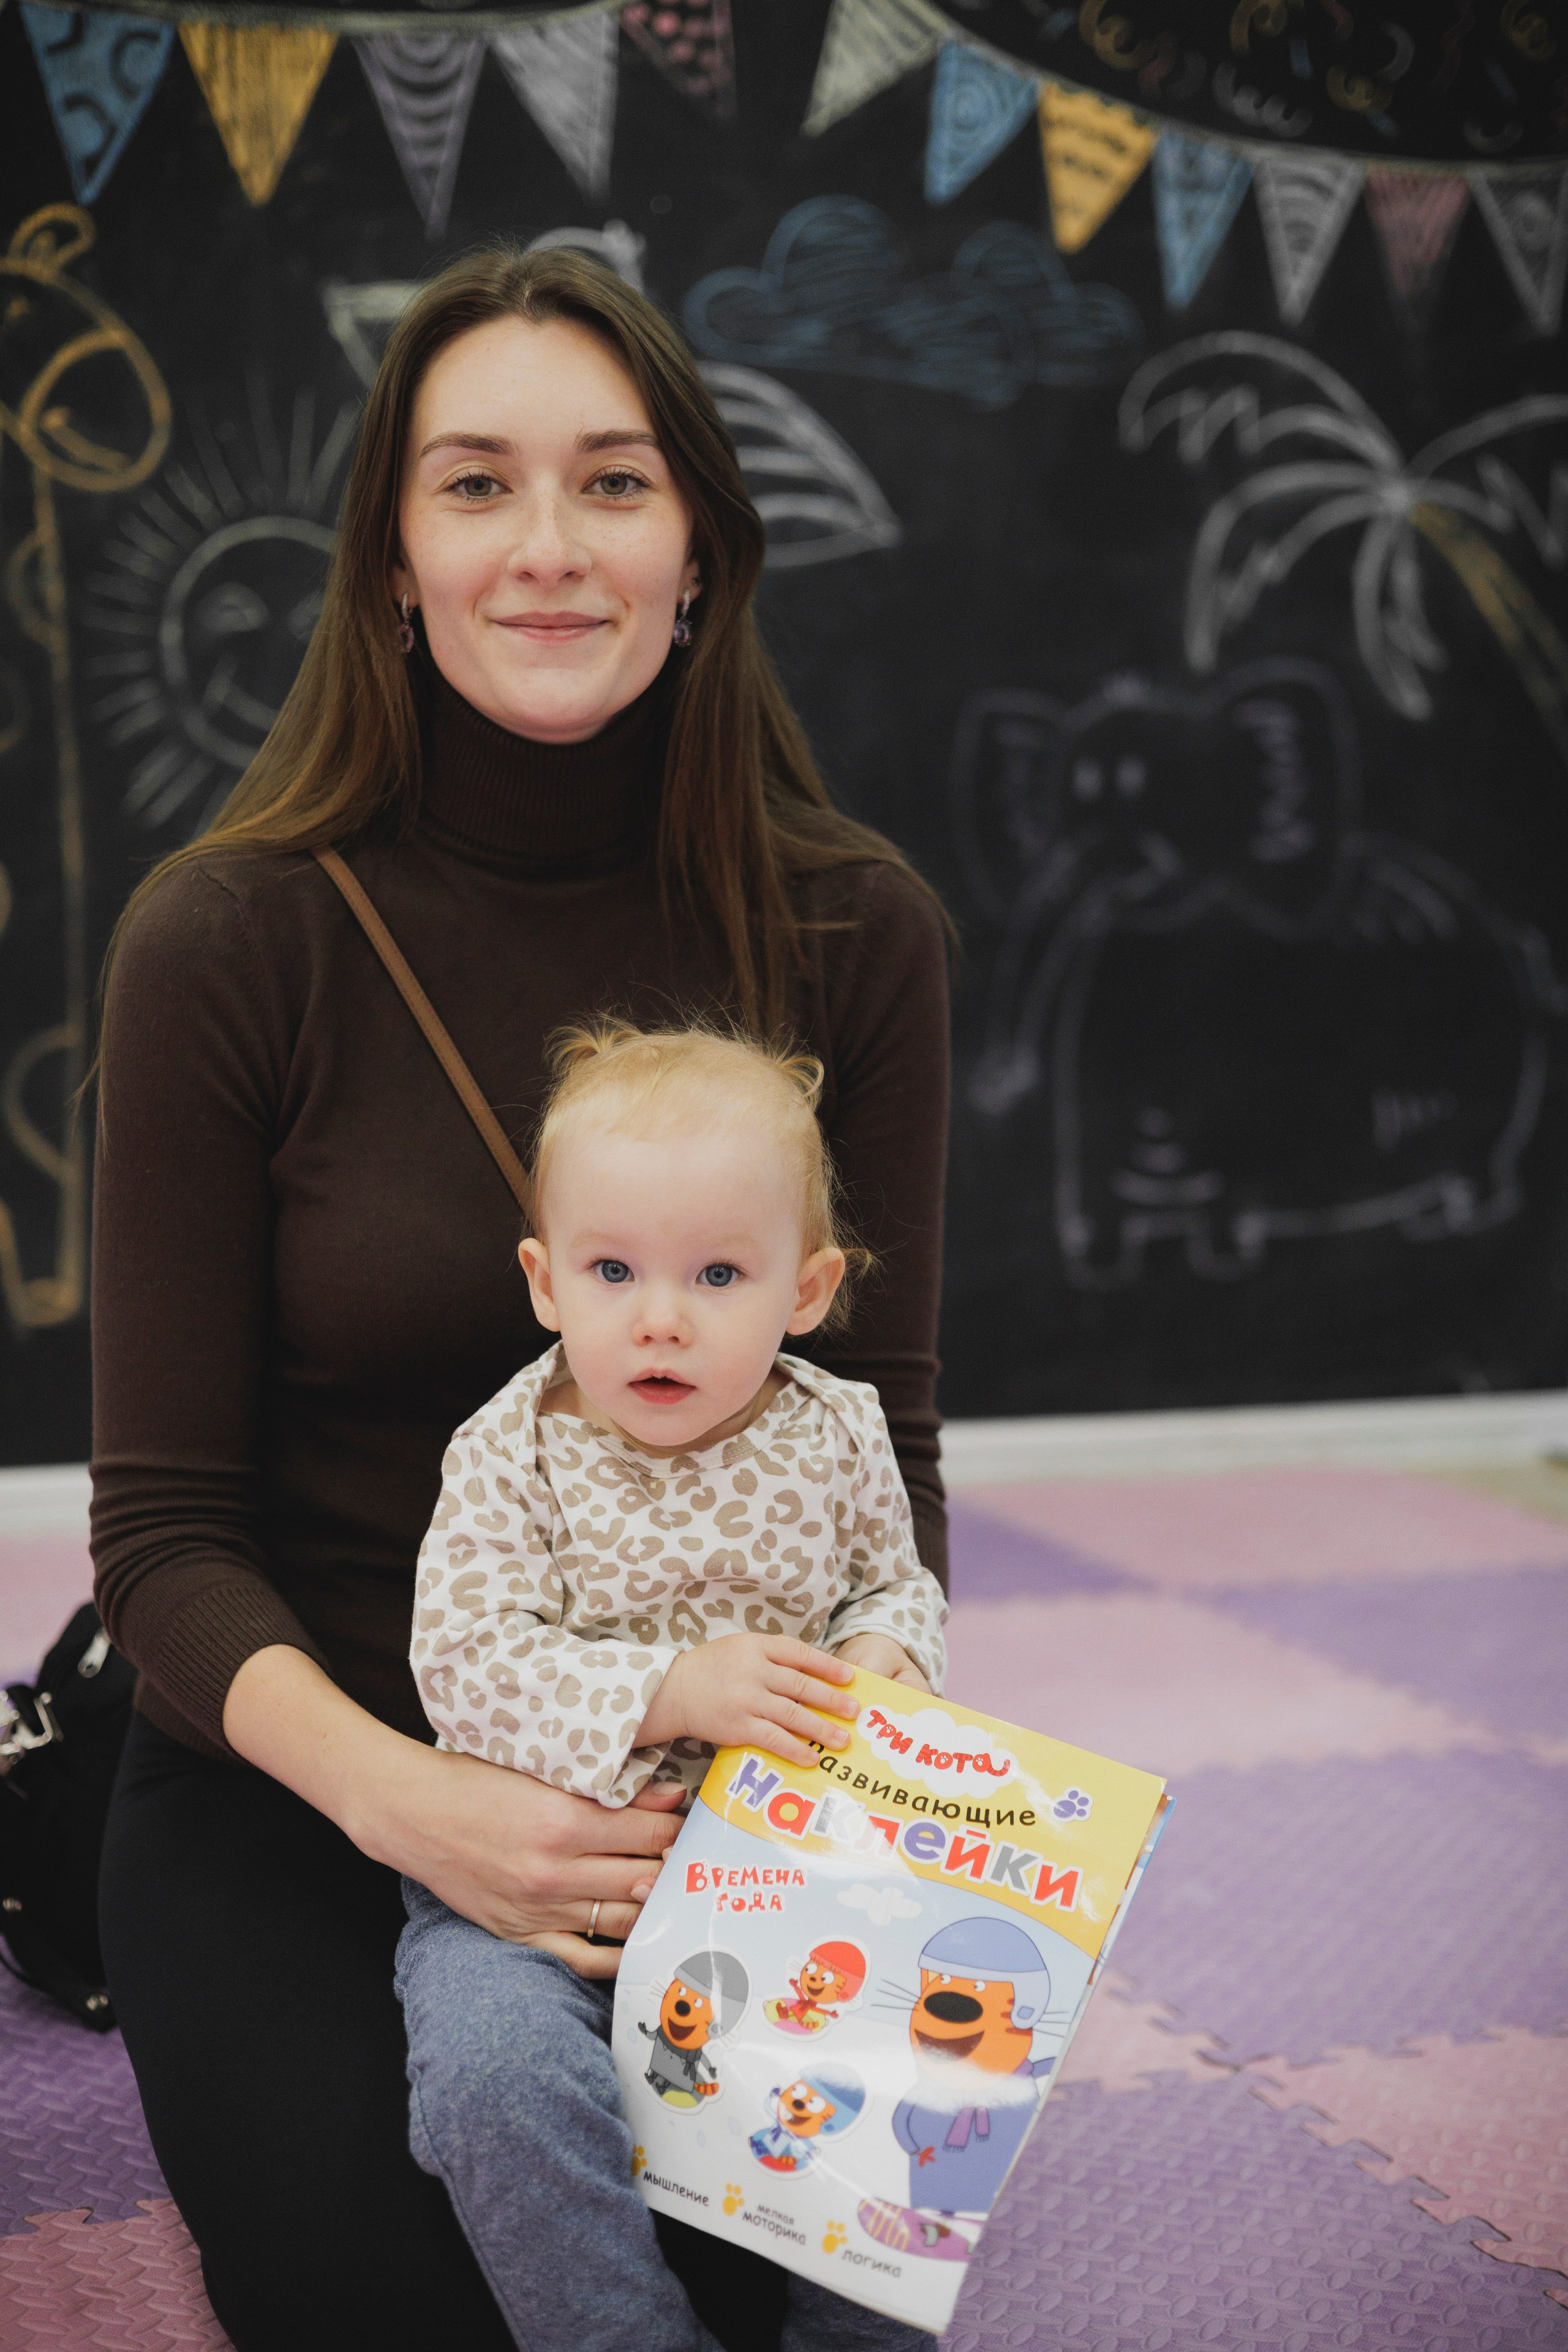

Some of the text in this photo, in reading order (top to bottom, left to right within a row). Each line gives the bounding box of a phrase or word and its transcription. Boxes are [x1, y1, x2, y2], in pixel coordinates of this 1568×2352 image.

[867, 1709, 1011, 1777] ТРИ КОТА
[728, 1757, 1080, 1908] Наклейки
[643, 2171, 709, 2207] мышление
[742, 2211, 806, 2245] моторика
[757, 2204, 794, 2225] мелкая
[842, 2249, 902, 2278] логика
